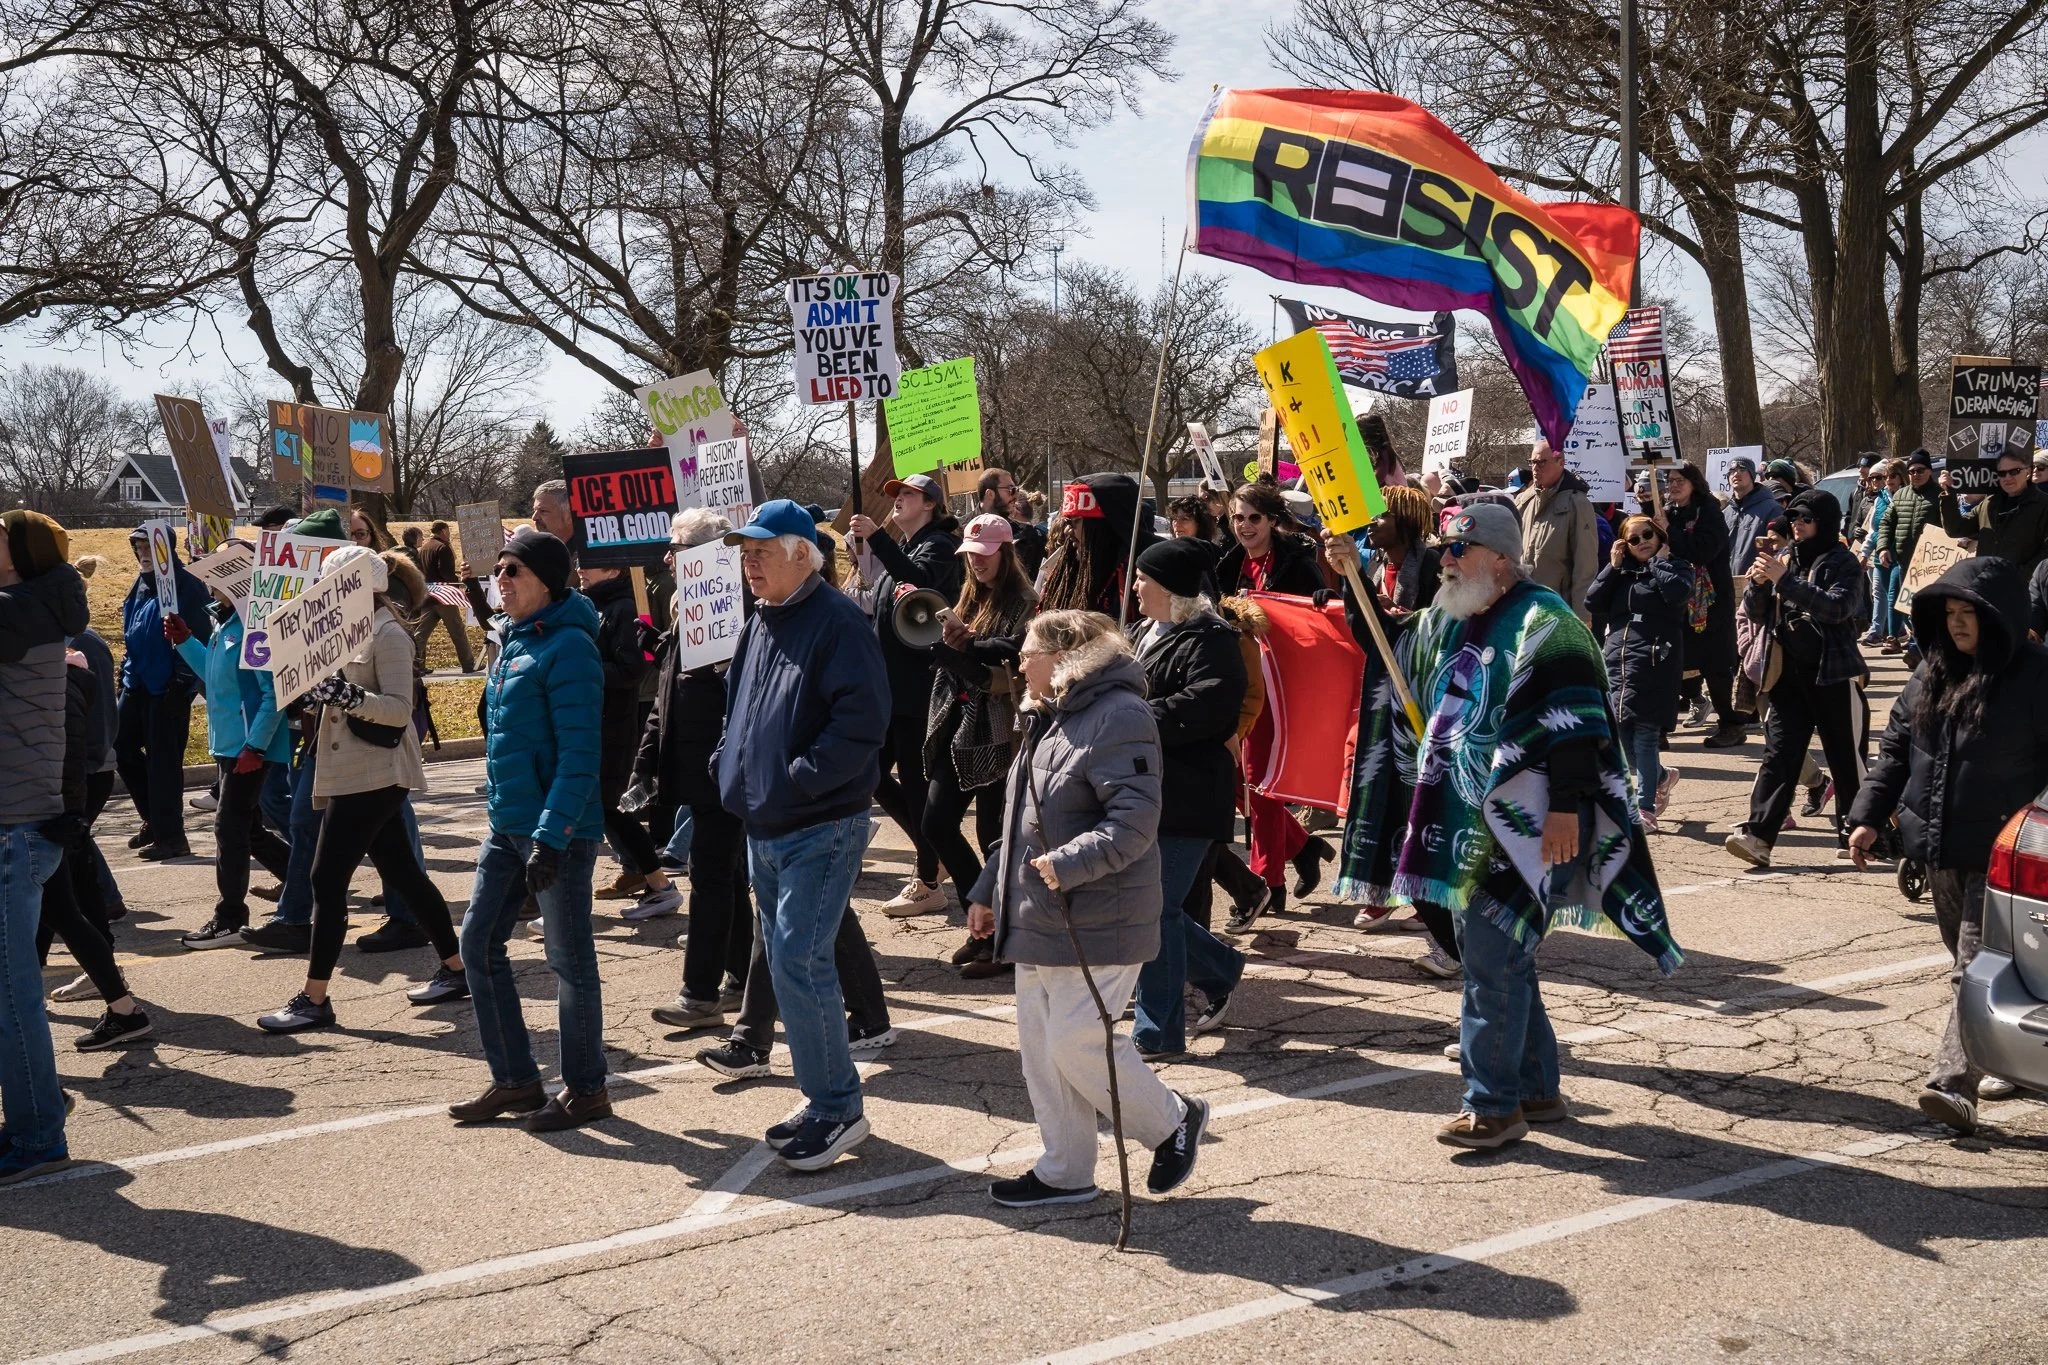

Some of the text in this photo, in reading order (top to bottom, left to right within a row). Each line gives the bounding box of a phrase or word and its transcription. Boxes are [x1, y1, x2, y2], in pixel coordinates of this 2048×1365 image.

[1253, 126, 1594, 339] RESIST
[793, 271, 890, 303] IT'S OK TO
[806, 299, 880, 328] ADMIT
[799, 324, 883, 354] YOU'VE
[1418, 321, 1438, 337] IN
[817, 350, 879, 378] BEEN
[1625, 361, 1650, 378] NO
[810, 376, 863, 403] LIED
[863, 373, 892, 399] TO
[899, 365, 963, 390] SCISM:
[1617, 374, 1664, 391] HUMAN
[1955, 367, 2038, 396] TRUMP'S
[1442, 398, 1459, 415] NO
[1632, 400, 1653, 413] ON
[1633, 389, 1664, 400] ILLEGAL
[158, 399, 197, 443] NO
[313, 413, 340, 446] NO
[1431, 420, 1466, 437] SECRET
[1622, 410, 1669, 426] STOLEN
[1632, 423, 1661, 440] LAND
[313, 445, 337, 459] KINGS
[705, 440, 739, 464] HISTORY
[327, 462, 340, 475] ICE
[699, 460, 745, 488] REPEATS IF
[577, 468, 665, 515] ICE OUT
[706, 485, 745, 508] WE STAY
[584, 513, 621, 545] FOR
[623, 509, 671, 543] GOOD
[1923, 541, 1954, 563] REST
[209, 556, 253, 579] LIBERTY
[683, 559, 703, 580] NO
[684, 576, 724, 602] KINGS
[273, 607, 302, 641] THEY
[335, 568, 363, 604] HANG
[685, 595, 734, 625] NO WAR
[302, 604, 343, 647] WITCHES
[686, 618, 730, 648] NO ICE
[276, 611, 374, 699] THEY HANGED WOMEN
